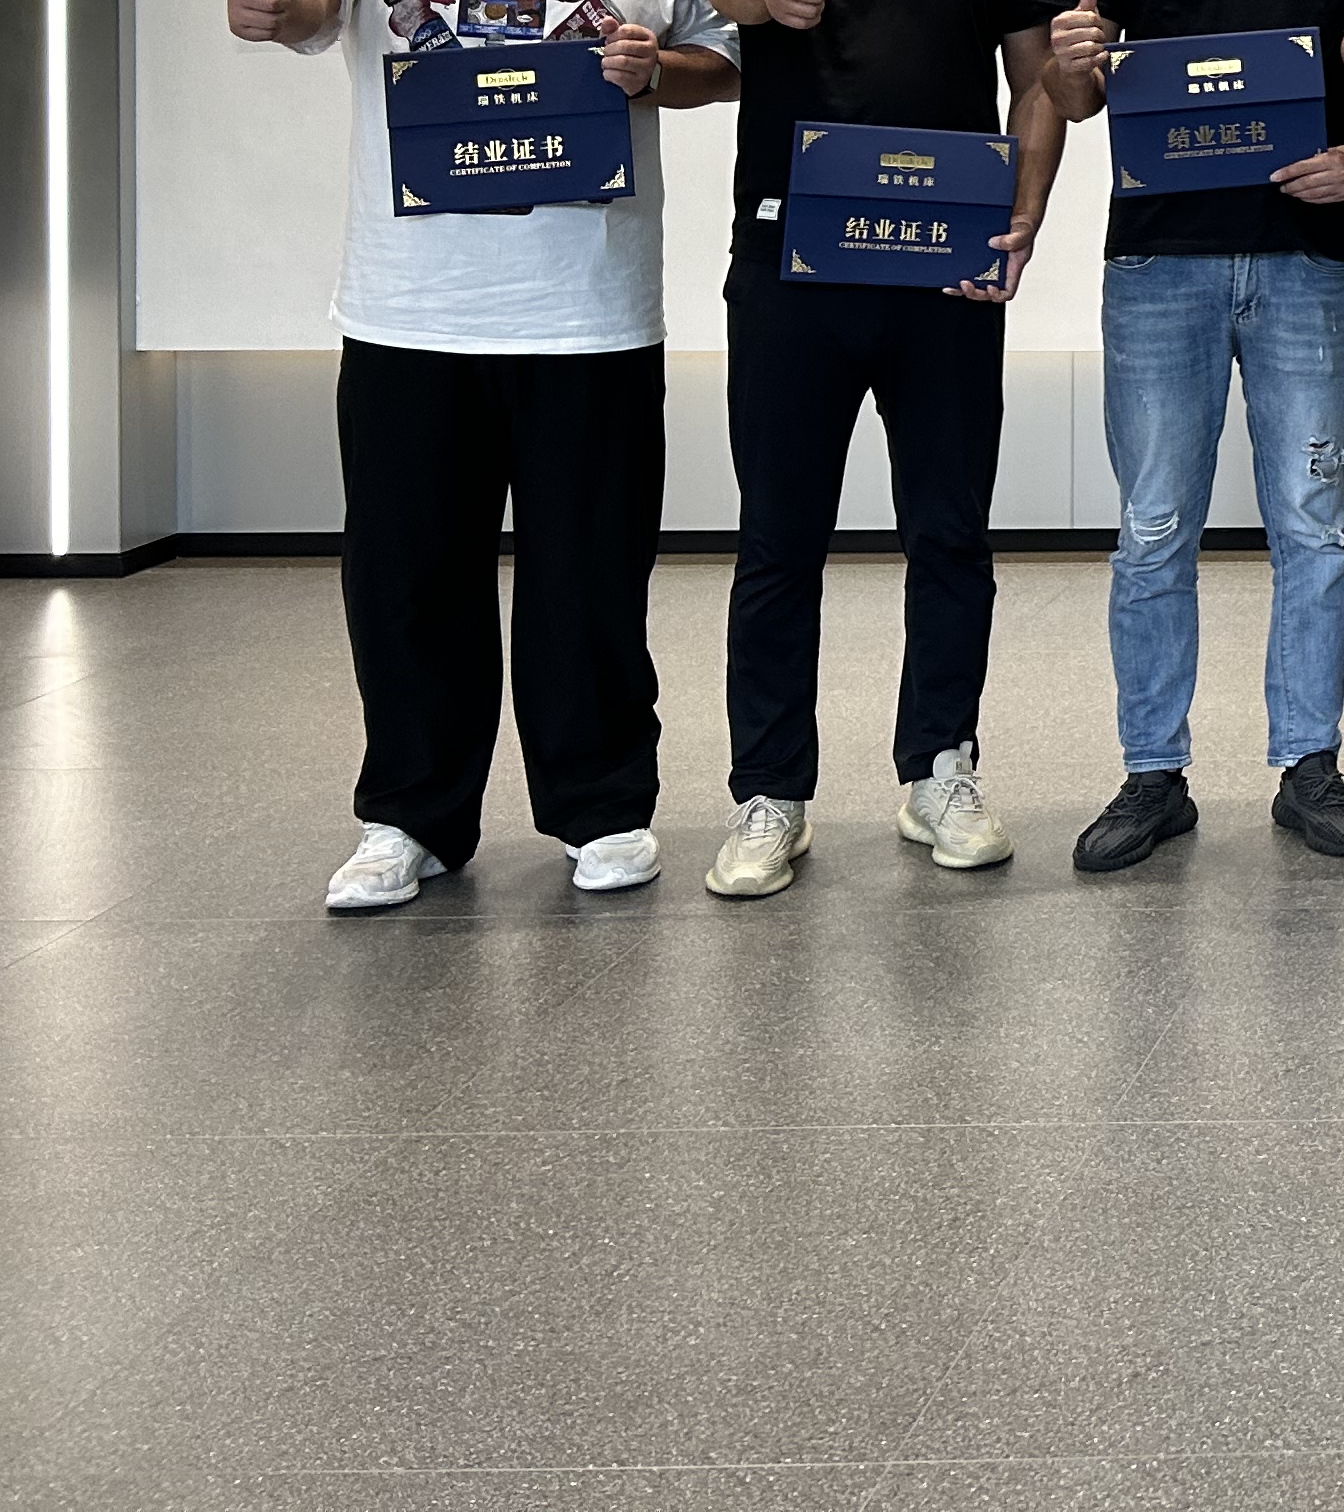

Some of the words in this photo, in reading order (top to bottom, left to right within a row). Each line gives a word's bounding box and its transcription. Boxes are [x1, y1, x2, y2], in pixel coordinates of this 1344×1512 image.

[1167, 120, 1266, 149] 结业证书
[454, 135, 564, 166] 结业证书
[844, 217, 948, 243] 结业证书
